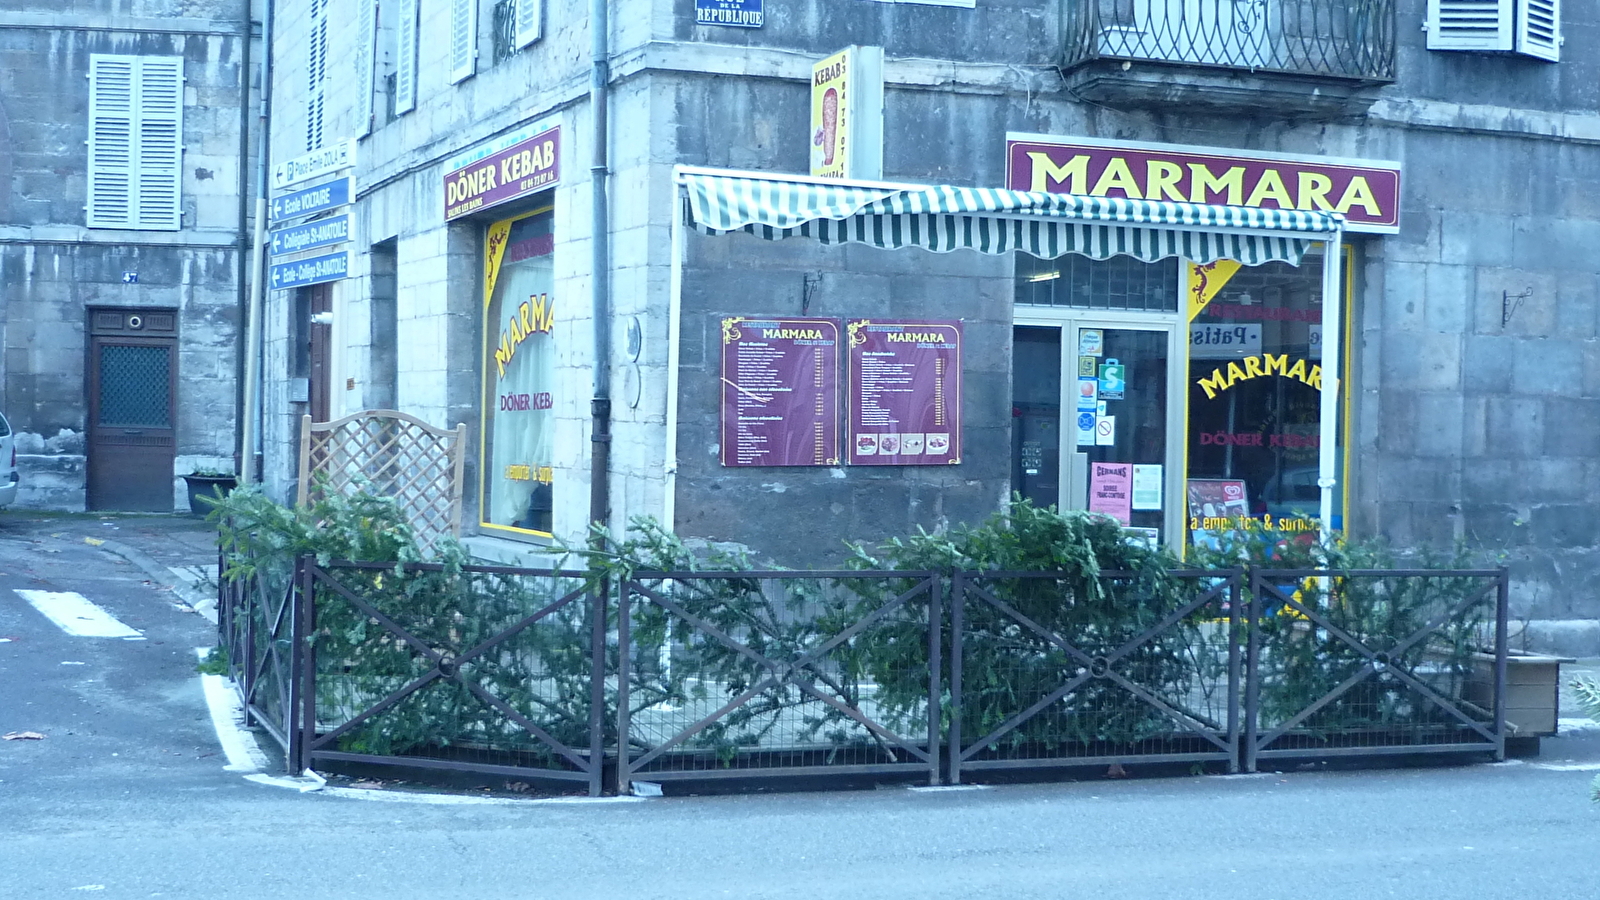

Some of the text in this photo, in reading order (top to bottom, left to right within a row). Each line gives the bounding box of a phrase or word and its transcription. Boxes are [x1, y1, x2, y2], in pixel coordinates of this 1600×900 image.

[697, 6, 762, 25] RÉPUBLIQUE
[814, 62, 841, 87] KEBAB
[295, 162, 308, 176] Place
[323, 149, 338, 167] ZOLA
[448, 165, 497, 206] DÖNER
[501, 140, 555, 185] KEBAB
[1025, 151, 1382, 217] MARMARA
[284, 187, 331, 215] Ecole VOLTAIRE
[123, 272, 137, 282] 47
[283, 267, 296, 283] Ecole
[763, 328, 823, 339] MARMARA
[887, 332, 945, 343] MARMARA
[1197, 353, 1340, 404] MARMAR
[500, 392, 530, 412] DÖNER
[1199, 430, 1263, 447] DÖNER
[1190, 517, 1198, 530] a
[1263, 513, 1273, 531] &
